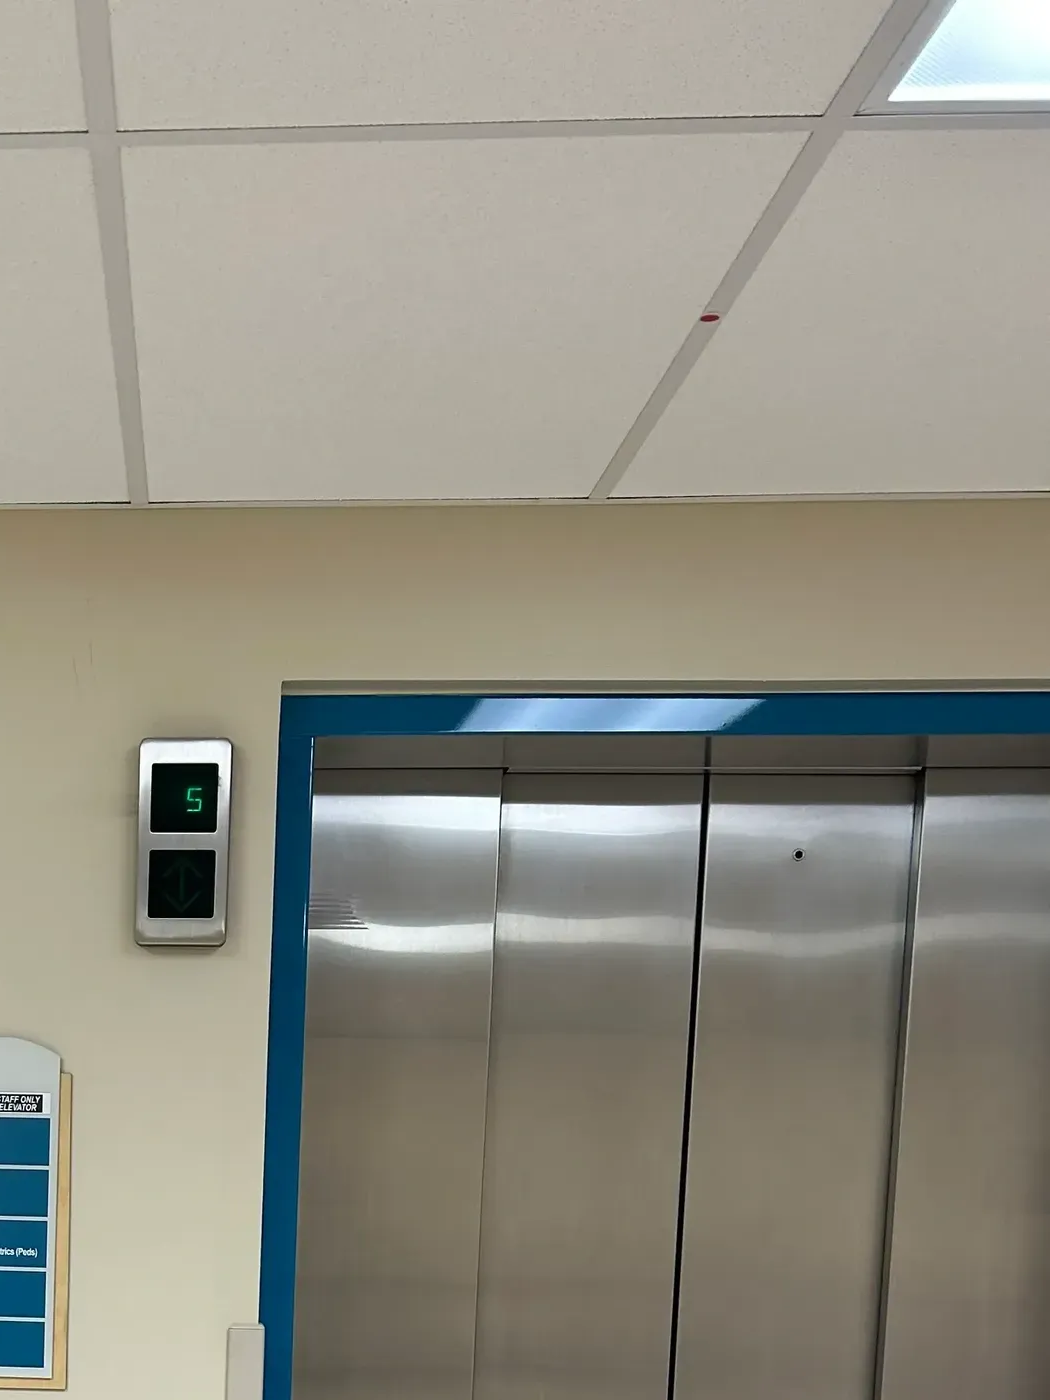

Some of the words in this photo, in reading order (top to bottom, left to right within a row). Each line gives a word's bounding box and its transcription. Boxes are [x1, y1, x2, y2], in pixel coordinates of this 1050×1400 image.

[186, 788, 202, 812] 5
[20, 1096, 40, 1104] ONLY
[16, 1248, 38, 1258] (Peds)
